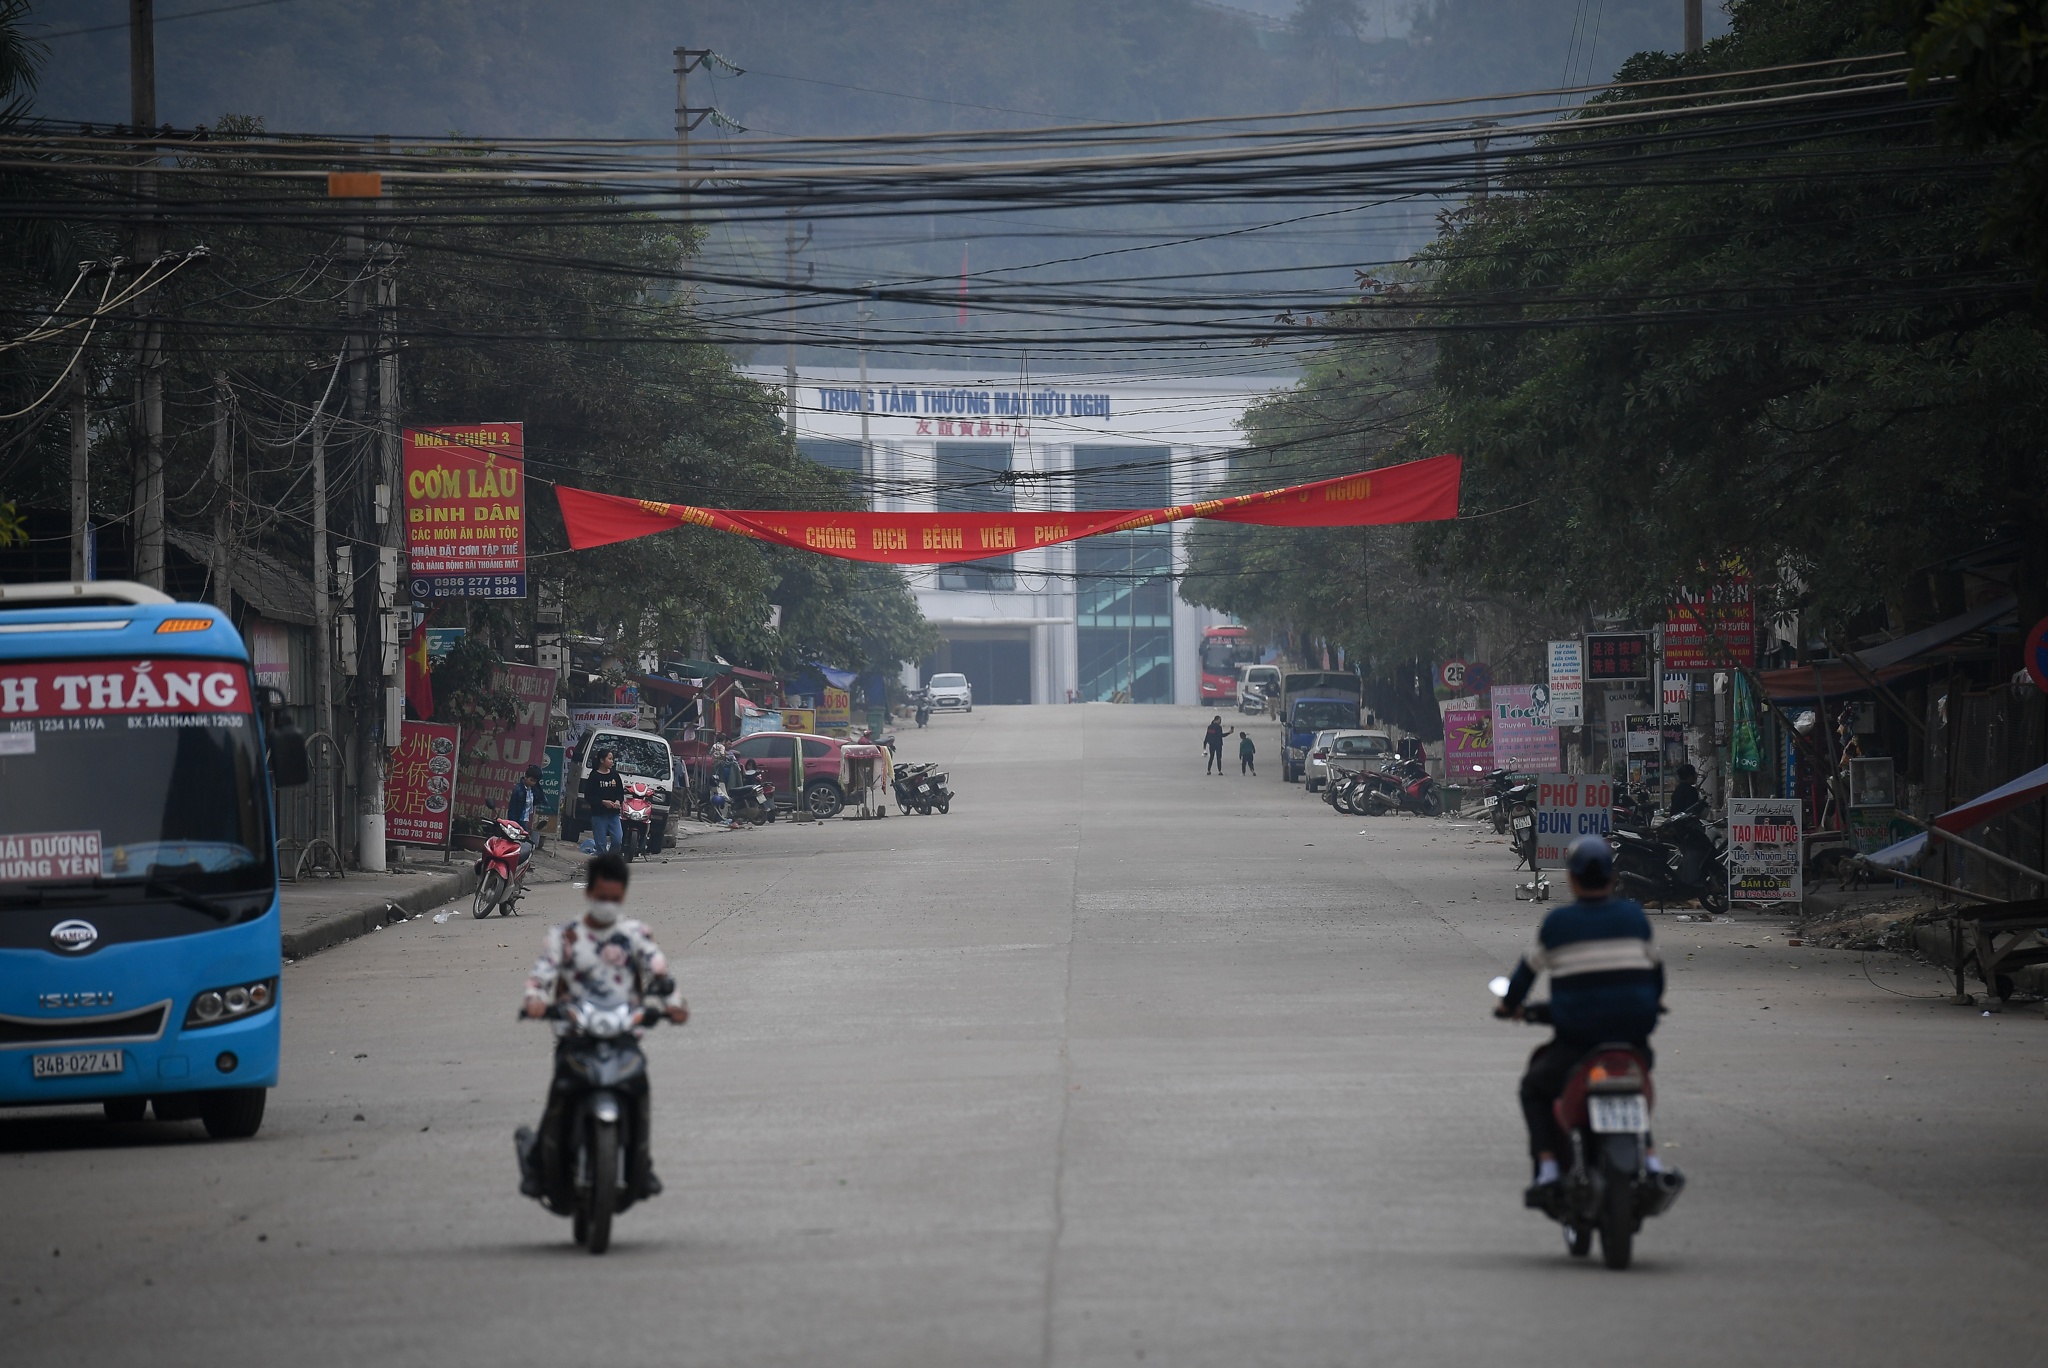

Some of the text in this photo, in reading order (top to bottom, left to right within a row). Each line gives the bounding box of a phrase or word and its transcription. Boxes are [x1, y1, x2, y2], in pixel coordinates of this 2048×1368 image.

[819, 388, 875, 412] TRUNG
[879, 385, 917, 413] TÂM
[921, 389, 990, 414] THƯƠNG
[1031, 387, 1066, 416] HỮU
[1070, 393, 1110, 421] NGHỊ
[414, 429, 450, 446] NHẤT
[501, 432, 510, 445] 3
[409, 451, 517, 499] CƠM LẨU
[410, 503, 520, 523] BÌNH DÂN
[411, 525, 519, 541] CÁC MÓN ĂN DÂN TỘC
[805, 519, 856, 549] CHỐNG
[872, 528, 908, 554] DỊCH
[922, 523, 963, 554] BỆNH
[980, 523, 1016, 548] VIÊM
[411, 541, 519, 558] NHẬN ĐẶT CƠM TẬP THỂ
[434, 577, 517, 586] 0986 277 594
[434, 587, 517, 597] 0944 530 888
[1680, 623, 1698, 632] QUAY
[1447, 667, 1463, 682] 25
[53, 660, 238, 710] THẮNG
[1566, 680, 1582, 690] NƯỚC
[1540, 776, 1610, 807] PHỞ BÒ
[1538, 809, 1571, 834] BÚN
[1578, 808, 1610, 834] CHẢ
[31, 836, 98, 857] DƯƠNG
[1537, 845, 1558, 859] BÚN
[58, 857, 99, 875] YÊN
[38, 992, 114, 1009] ISUZU
